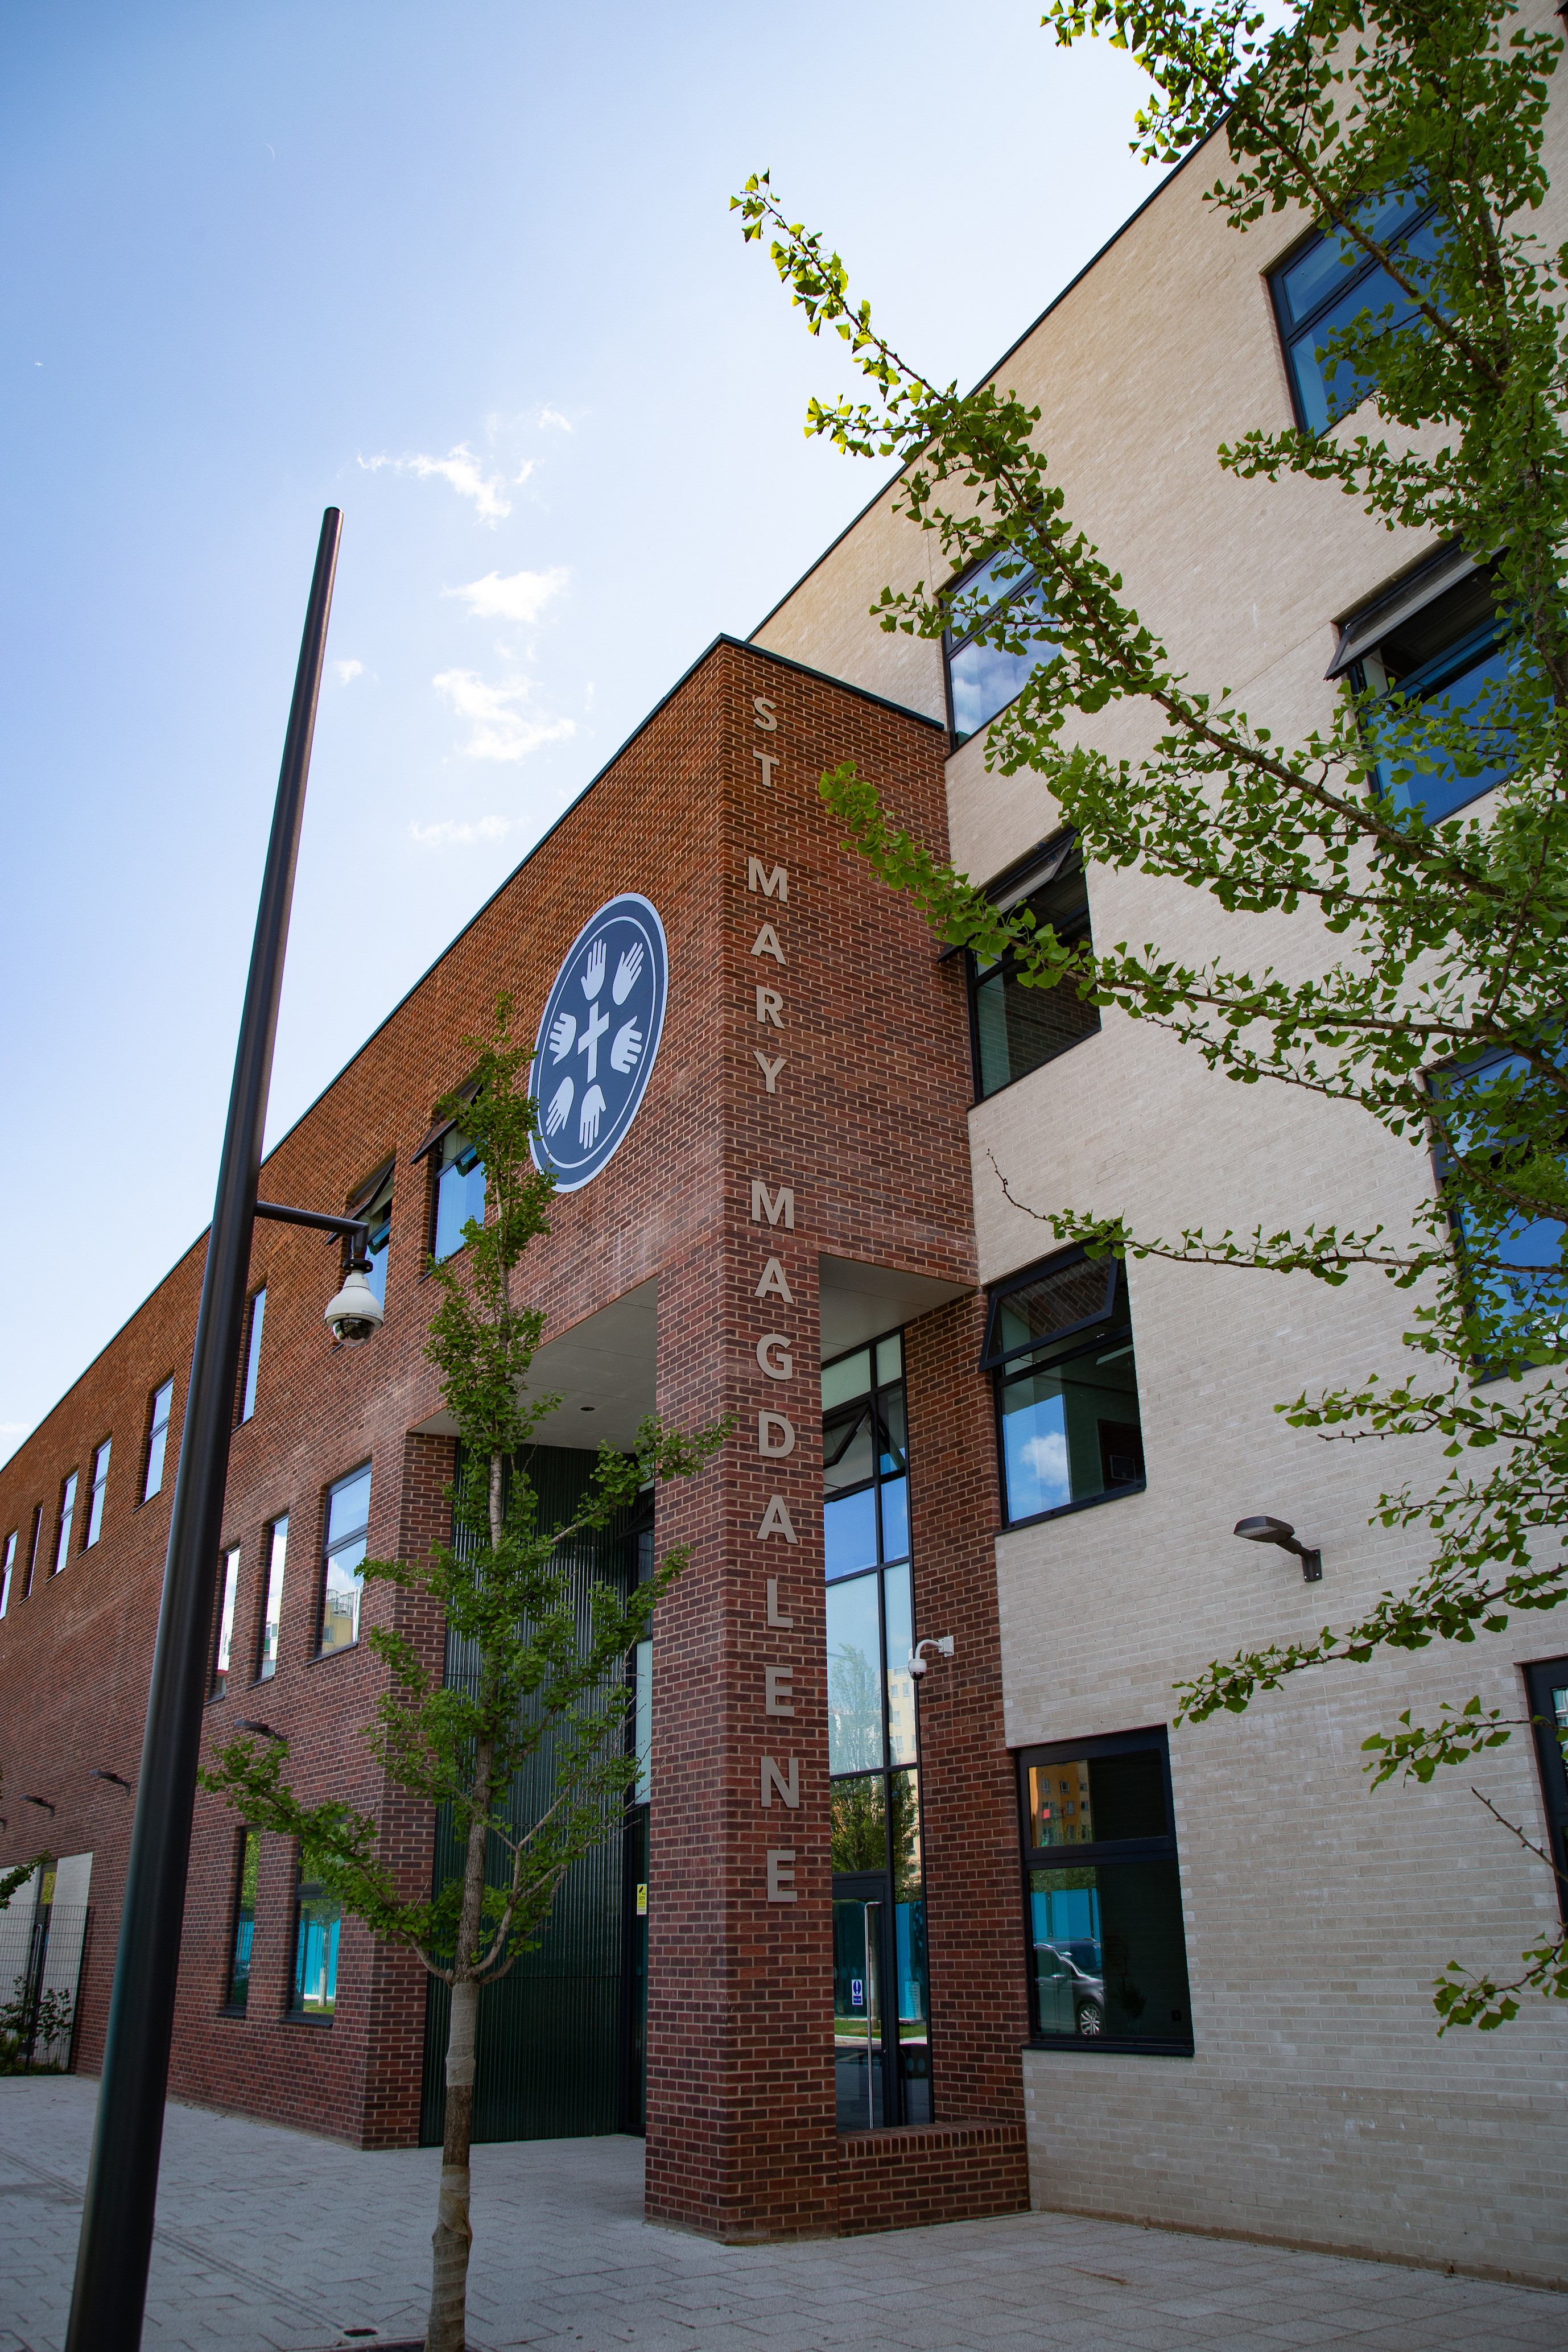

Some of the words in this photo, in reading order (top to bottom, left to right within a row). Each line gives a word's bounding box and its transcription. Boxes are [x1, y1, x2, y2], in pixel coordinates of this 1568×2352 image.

[753, 696, 779, 787] ST
[748, 856, 788, 1094] MARY
[751, 1179, 800, 1903] MAGDALENE
